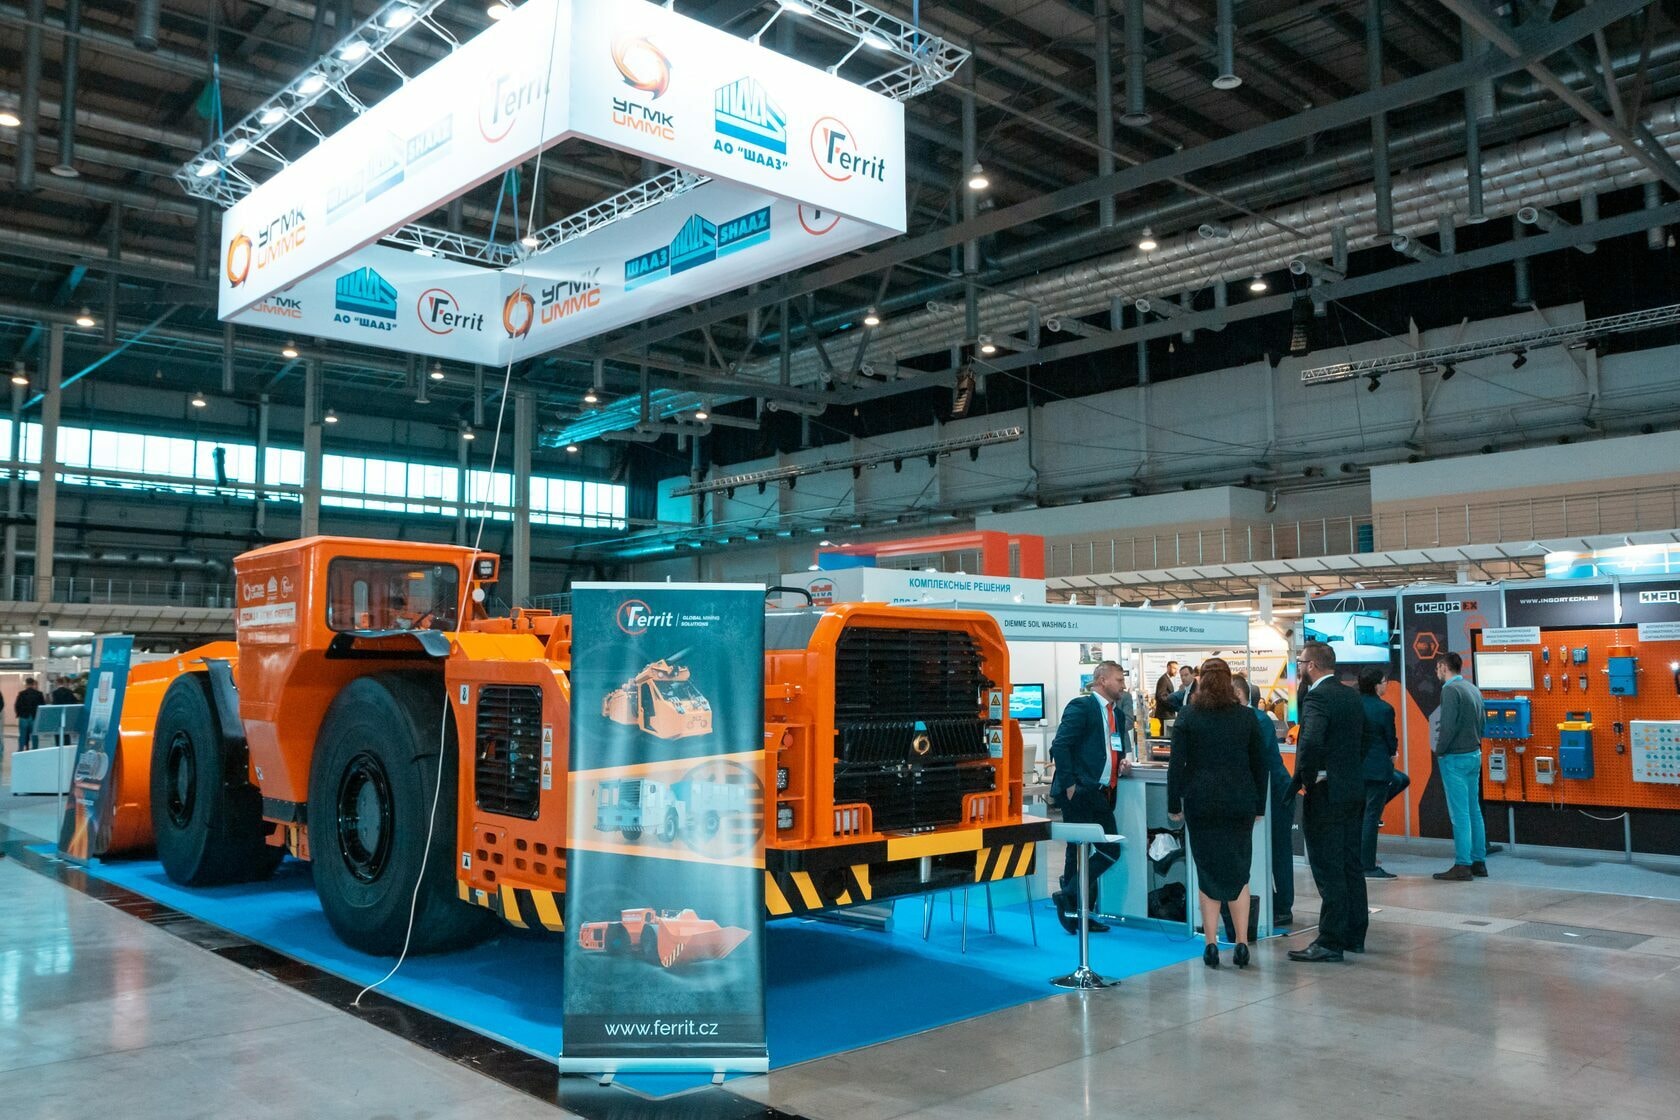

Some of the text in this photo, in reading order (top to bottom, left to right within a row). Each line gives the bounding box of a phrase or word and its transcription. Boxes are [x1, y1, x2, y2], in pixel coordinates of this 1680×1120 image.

[613, 97, 674, 129] УГМК
[612, 115, 675, 141] UMMC
[713, 140, 734, 155] АО
[825, 128, 886, 182] Ferrit
[258, 203, 306, 248] УГМК
[720, 211, 768, 243] SHAAZ
[257, 225, 306, 270] UMMC
[626, 250, 668, 277] ШААЗ
[334, 314, 351, 326] АО
[428, 296, 484, 332] Ferrit
[541, 288, 601, 325] UMMC
[909, 578, 1011, 592] КОМПЛЕКСНЫЕ РЕШЕНИЯ
[627, 605, 673, 627] Ferrit
[1028, 620, 1041, 628] SOIL
[1042, 621, 1067, 629] WASHING
[605, 1020, 718, 1036] www.ferrit.cz
